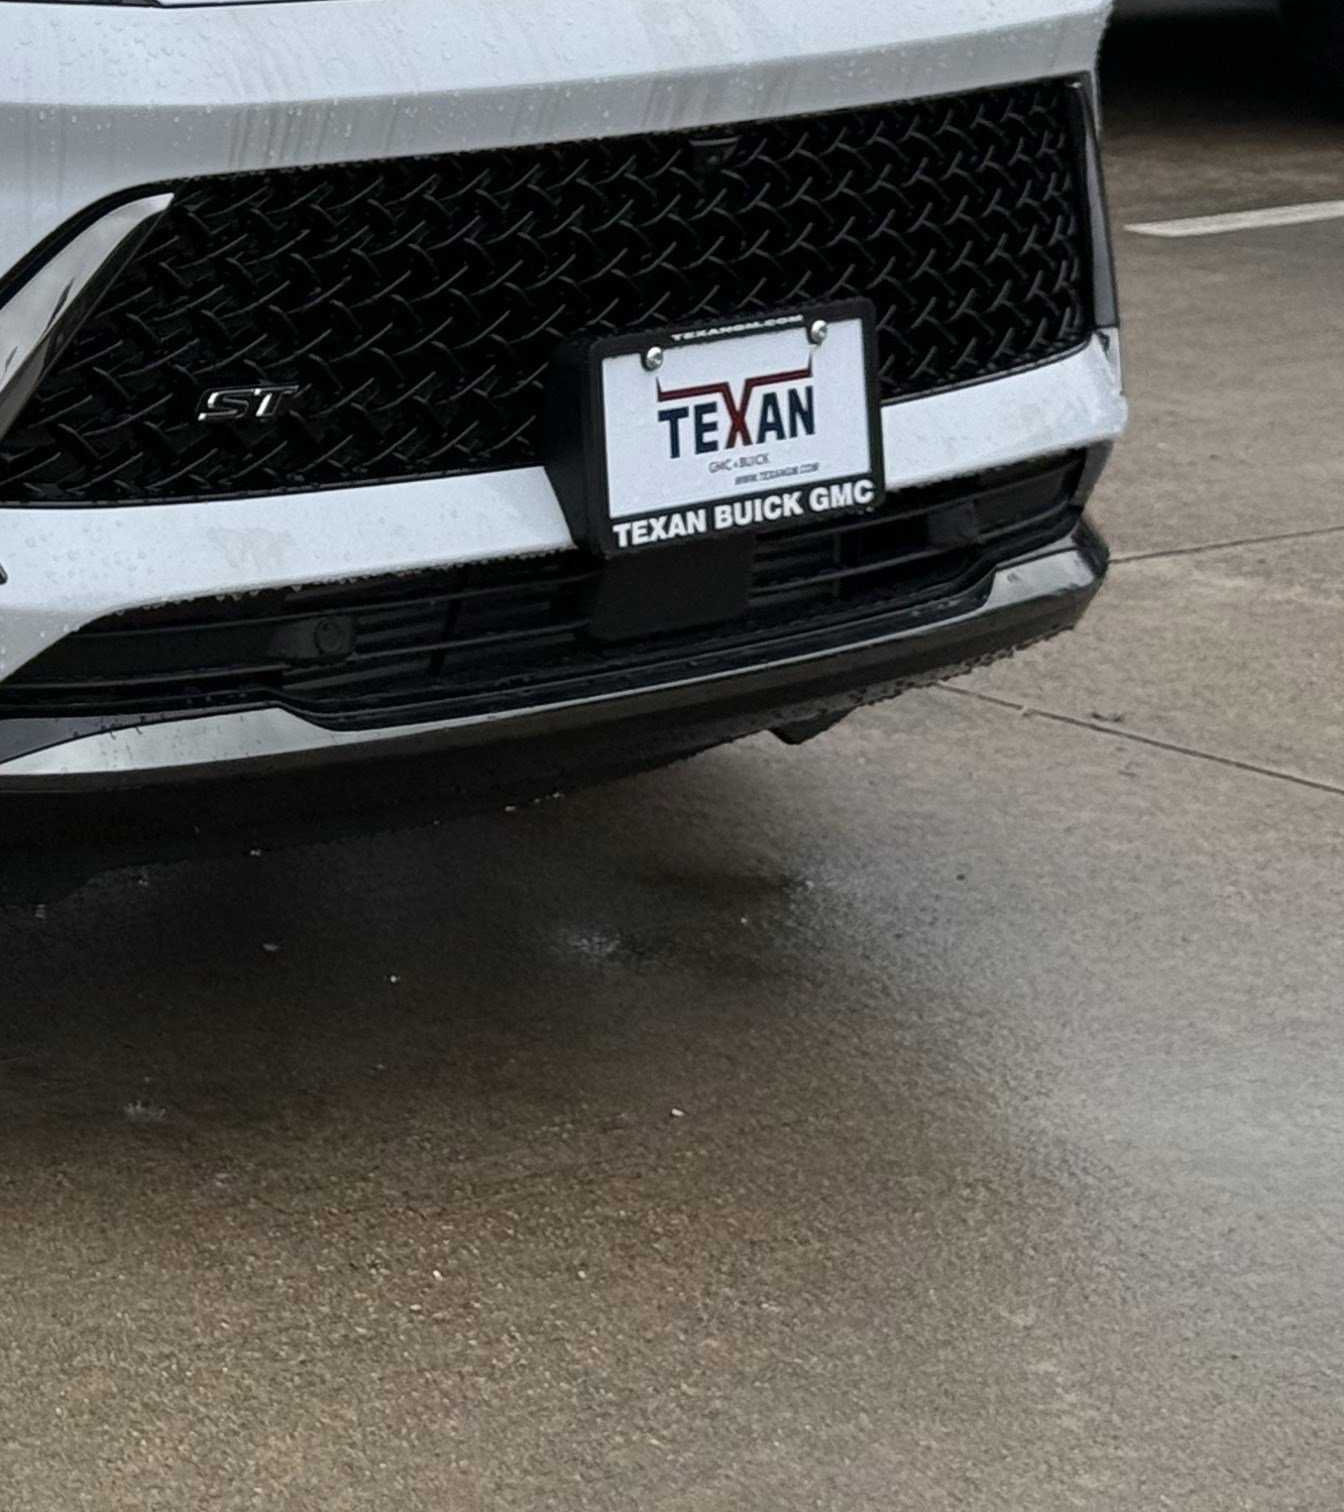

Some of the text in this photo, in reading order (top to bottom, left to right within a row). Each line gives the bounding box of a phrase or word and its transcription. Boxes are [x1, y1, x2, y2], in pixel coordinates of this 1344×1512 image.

[195, 385, 299, 422] ST
[657, 372, 816, 459] TEXAN
[613, 479, 875, 548] TEXAN BUICK GMC
